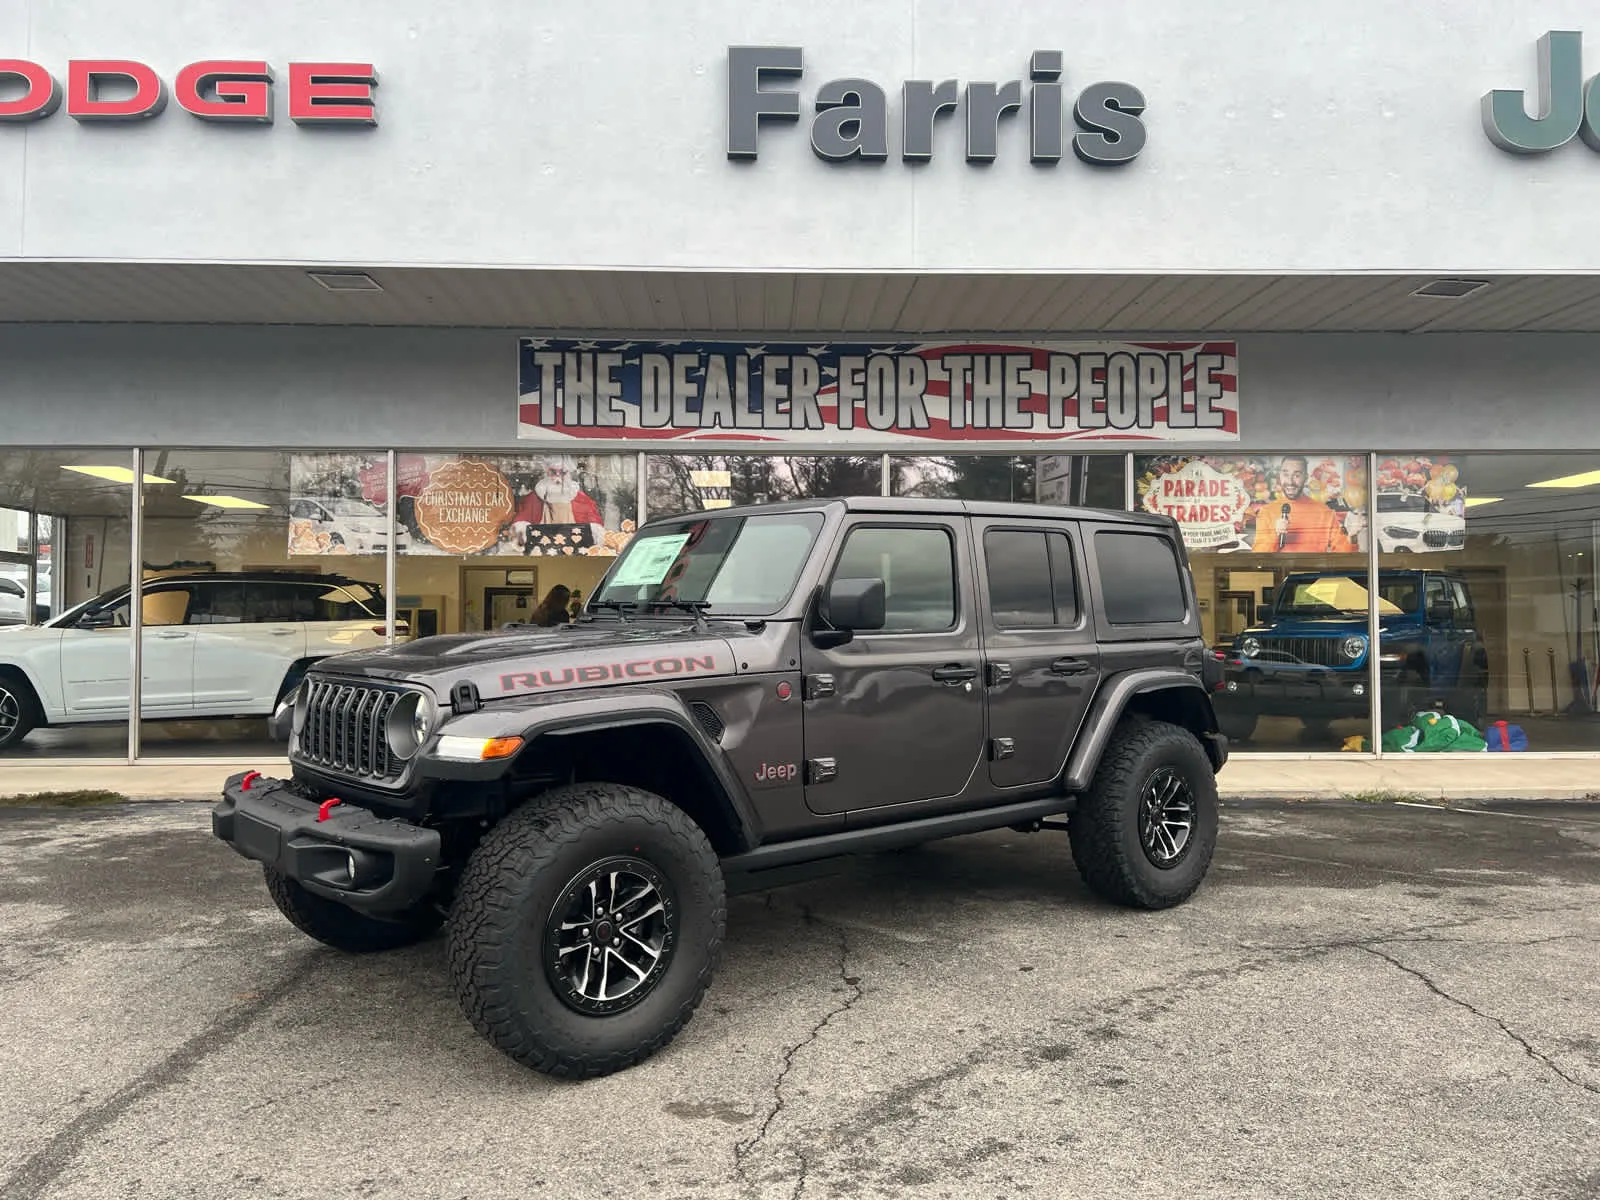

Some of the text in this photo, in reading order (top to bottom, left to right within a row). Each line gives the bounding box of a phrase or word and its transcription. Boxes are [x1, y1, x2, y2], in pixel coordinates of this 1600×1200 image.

[1480, 30, 1600, 155] J
[727, 45, 1147, 165] Farris
[533, 350, 1226, 430] THE DEALER FOR THE PEOPLE
[1163, 479, 1230, 497] PARADE
[425, 490, 505, 507] CHRISTMAS CAR
[439, 508, 492, 523] EXCHANGE
[1163, 504, 1231, 523] TRADES
[499, 655, 716, 691] RUBICON
[755, 763, 797, 781] Jeep
